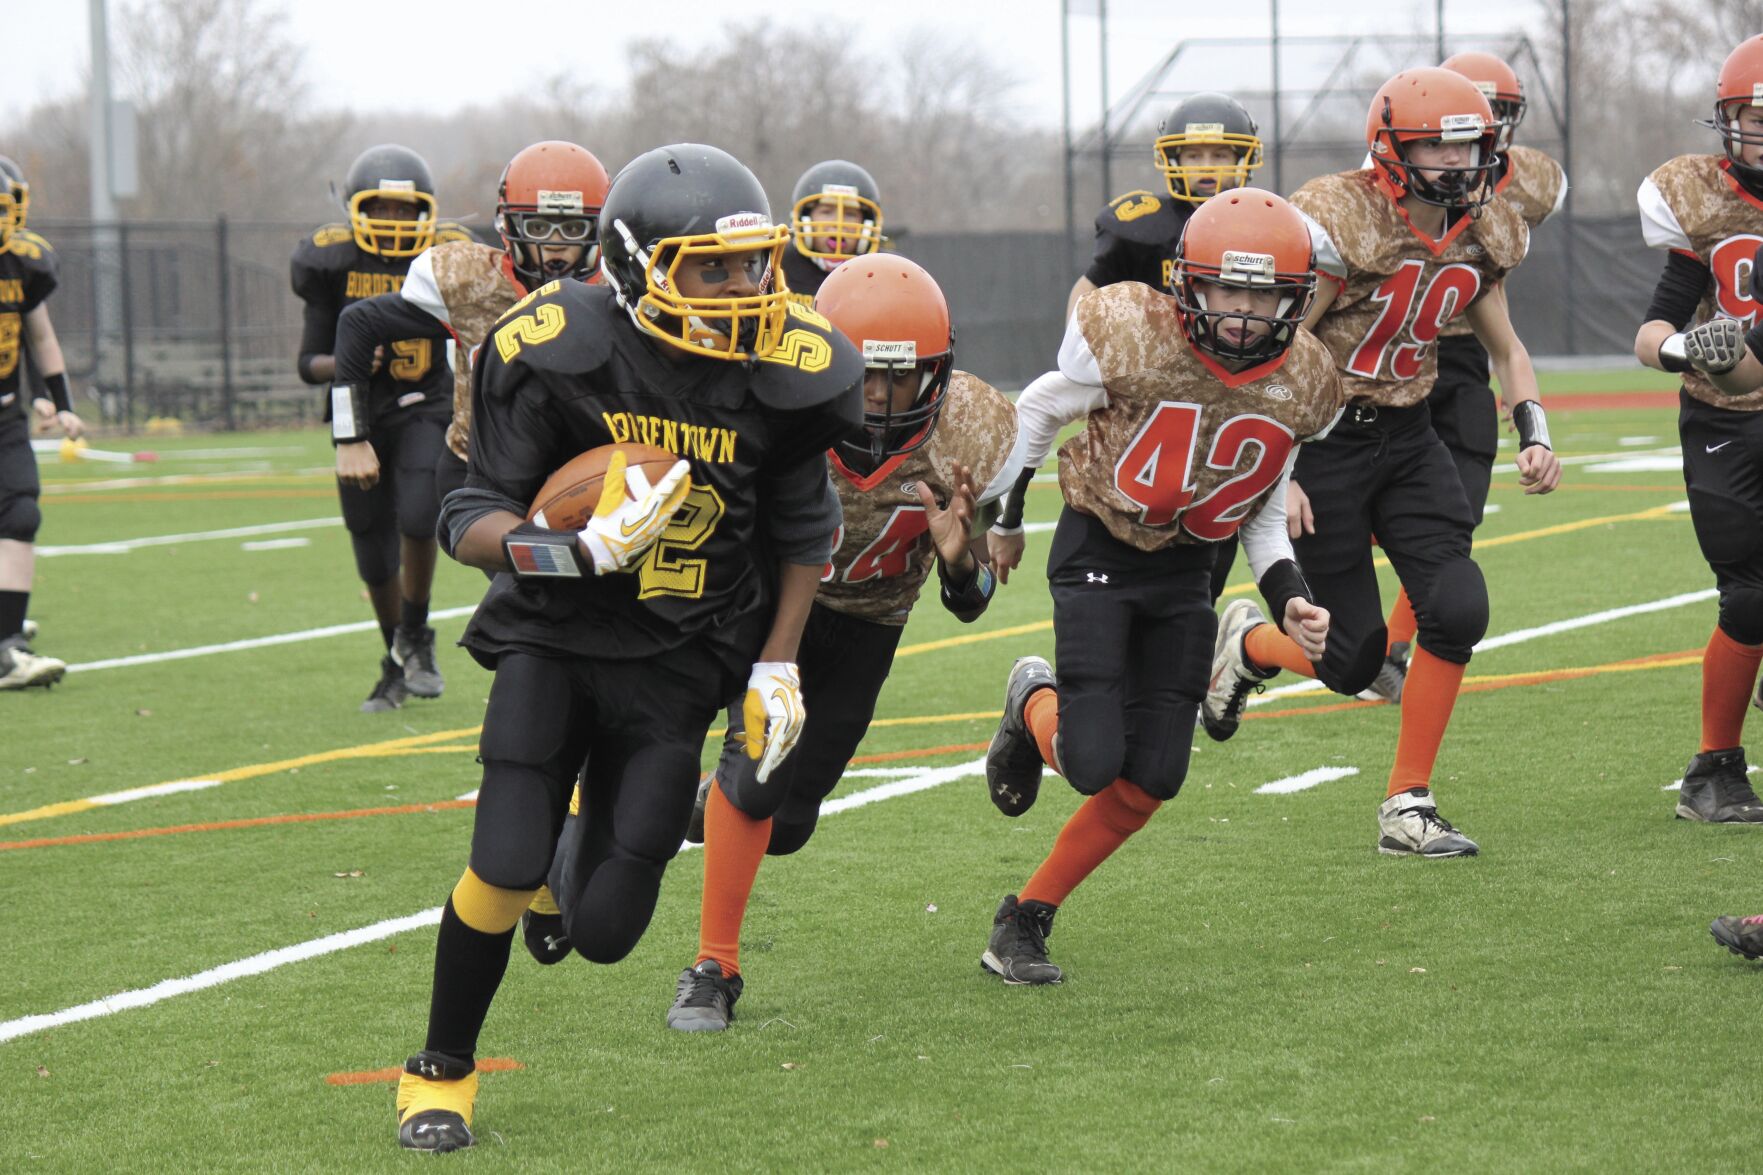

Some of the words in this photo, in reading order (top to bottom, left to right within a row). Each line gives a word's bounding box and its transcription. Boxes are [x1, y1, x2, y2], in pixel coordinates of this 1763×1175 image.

[729, 216, 759, 228] Riddell
[875, 344, 902, 352] SCHUTT
[1345, 259, 1481, 380] 19
[1114, 400, 1295, 542] 42
[620, 484, 726, 600] 2
[820, 505, 930, 584] 4
